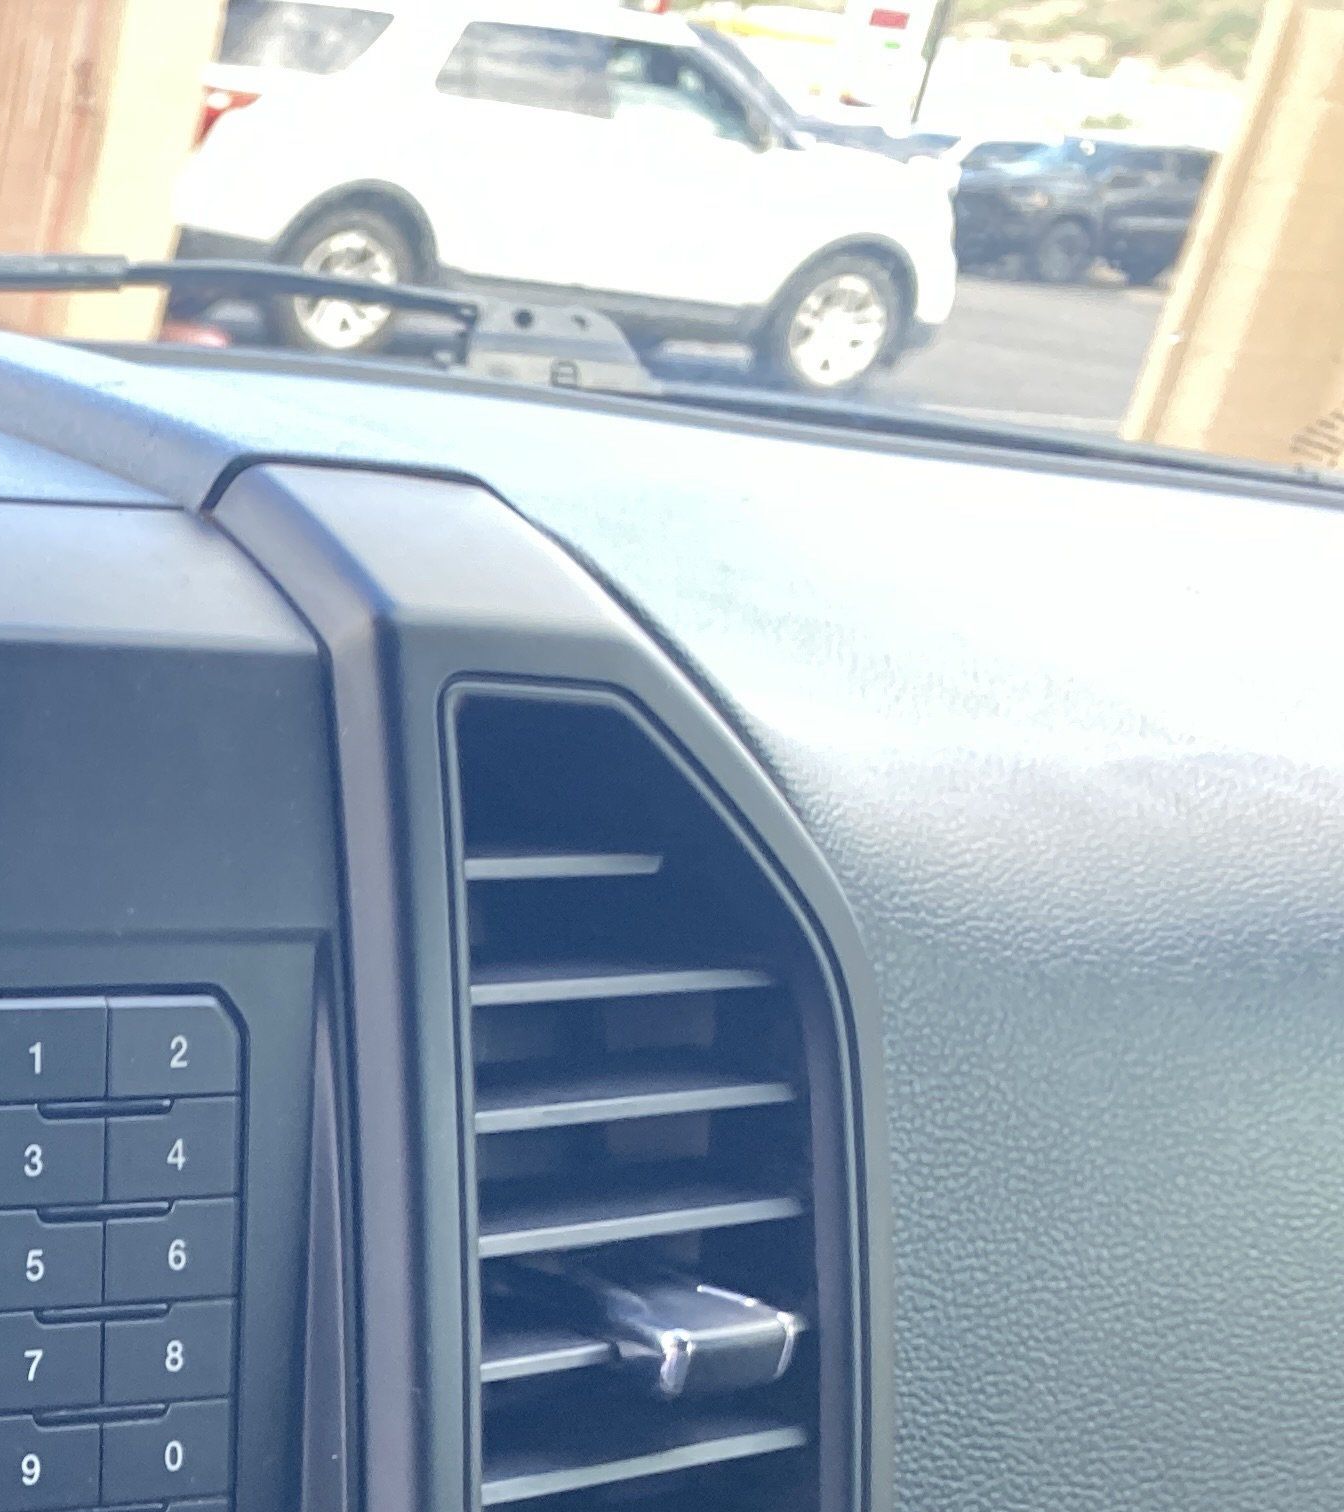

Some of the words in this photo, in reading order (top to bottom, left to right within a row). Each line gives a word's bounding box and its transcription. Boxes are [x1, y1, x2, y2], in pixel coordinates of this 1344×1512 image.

[28, 1041, 42, 1074] 1
[170, 1035, 188, 1069] 2
[24, 1143, 43, 1177] 3
[166, 1138, 187, 1171] 4
[25, 1249, 45, 1282] 5
[168, 1238, 187, 1271] 6
[24, 1349, 43, 1382] 7
[165, 1339, 184, 1372] 8
[21, 1453, 41, 1486] 9
[164, 1440, 183, 1472] 0
